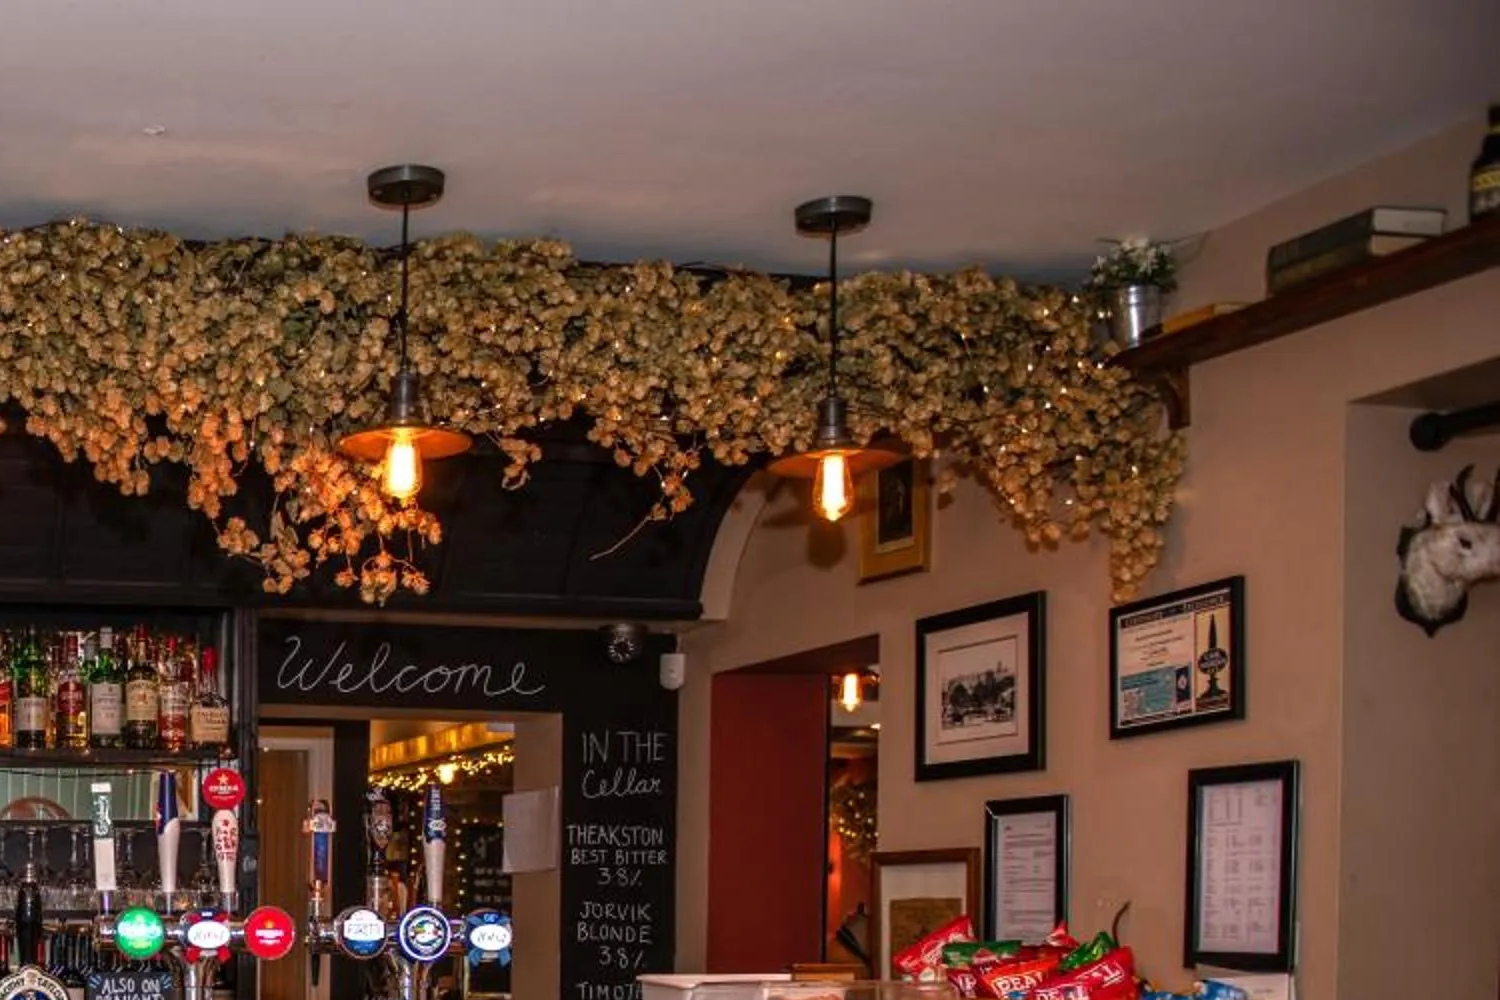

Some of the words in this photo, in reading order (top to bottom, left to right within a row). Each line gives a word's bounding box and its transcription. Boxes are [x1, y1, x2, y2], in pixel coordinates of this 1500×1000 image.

[277, 635, 546, 697] Welcome
[581, 731, 610, 763] IN
[617, 731, 669, 763] THE
[581, 767, 663, 799] Cellar
[567, 824, 665, 847] THEAKSTON
[570, 848, 605, 865] BEST
[615, 849, 668, 865] BITTER
[579, 901, 652, 921] JORVIK
[577, 921, 654, 944] BLONDE
[101, 977, 135, 994] ALSO
[141, 978, 161, 993] ON
